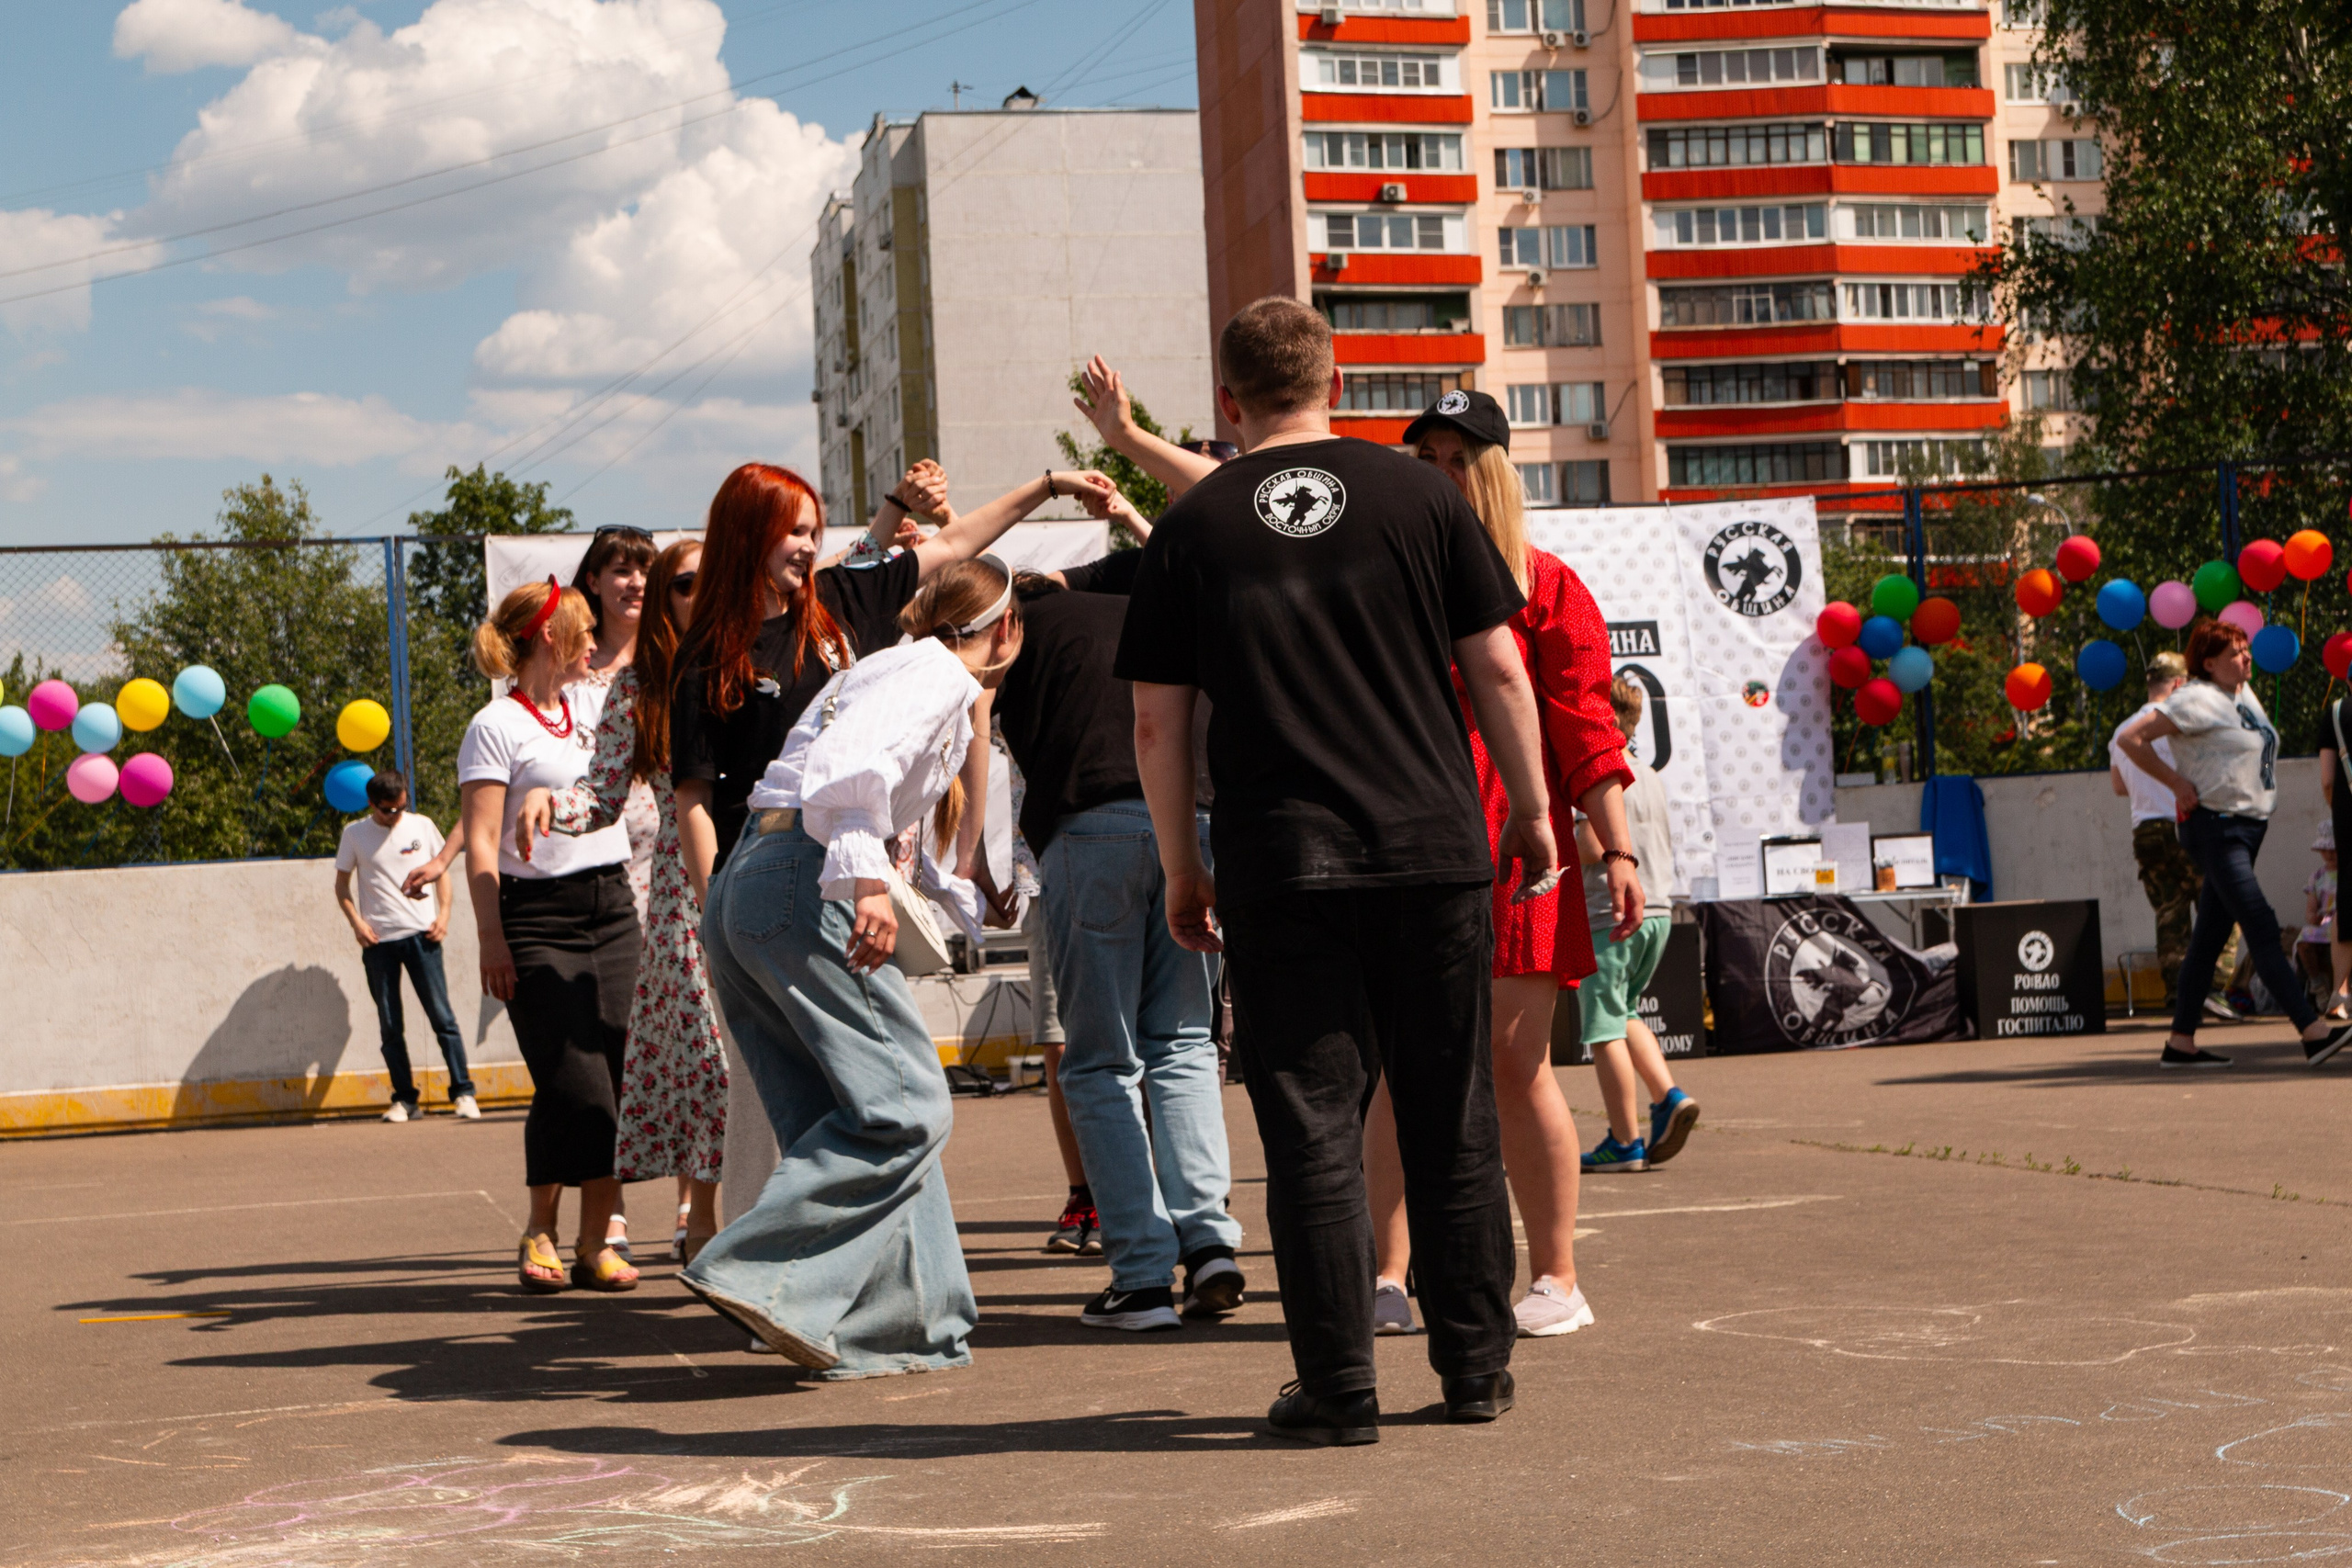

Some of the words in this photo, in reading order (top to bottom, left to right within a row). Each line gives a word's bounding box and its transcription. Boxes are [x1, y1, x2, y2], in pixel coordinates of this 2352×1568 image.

[1259, 472, 1292, 503] РУССКАЯ
[1297, 469, 1340, 493] ОБЩИНА
[1265, 513, 1321, 534] ВОСТОЧНЫЙ
[1322, 502, 1340, 525] ОКРУГ
[1707, 522, 1793, 558] РУССКАЯ
[1716, 584, 1796, 616] ОБЩИНА
[1609, 628, 1657, 655] ИНА
[1772, 913, 1894, 964] РУССКАЯ
[2010, 996, 2069, 1014] ПОМОЩЬ
[1782, 1008, 1900, 1045] ОБЩИНА
[1997, 1014, 2085, 1035] ГОСПИТАЛЮ
